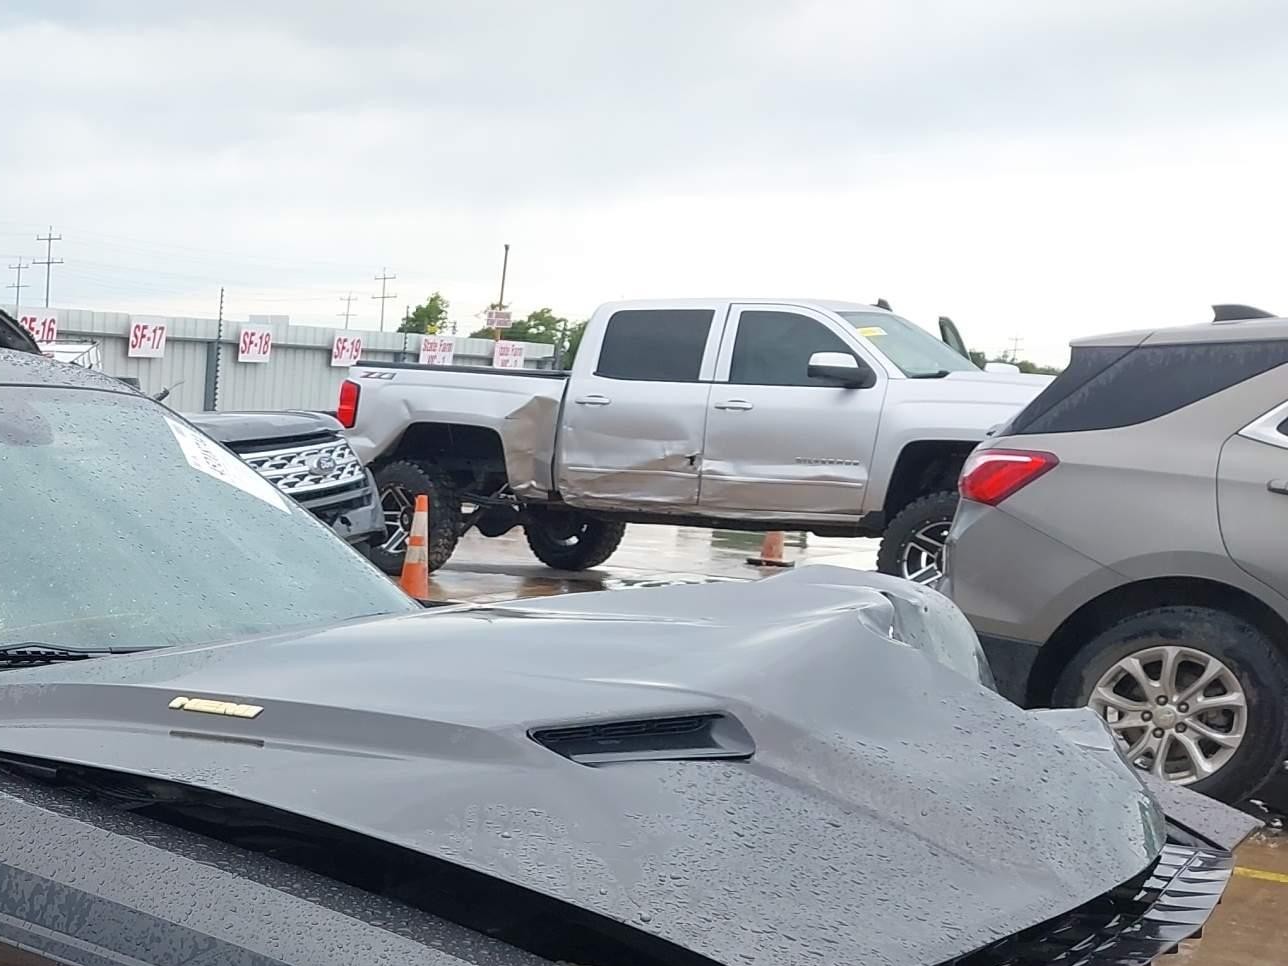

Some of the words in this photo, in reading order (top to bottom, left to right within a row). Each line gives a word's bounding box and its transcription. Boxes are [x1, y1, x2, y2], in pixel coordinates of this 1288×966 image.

[130, 323, 166, 351] SF-17
[240, 331, 271, 355] SF-18
[333, 337, 362, 360] SF-19
